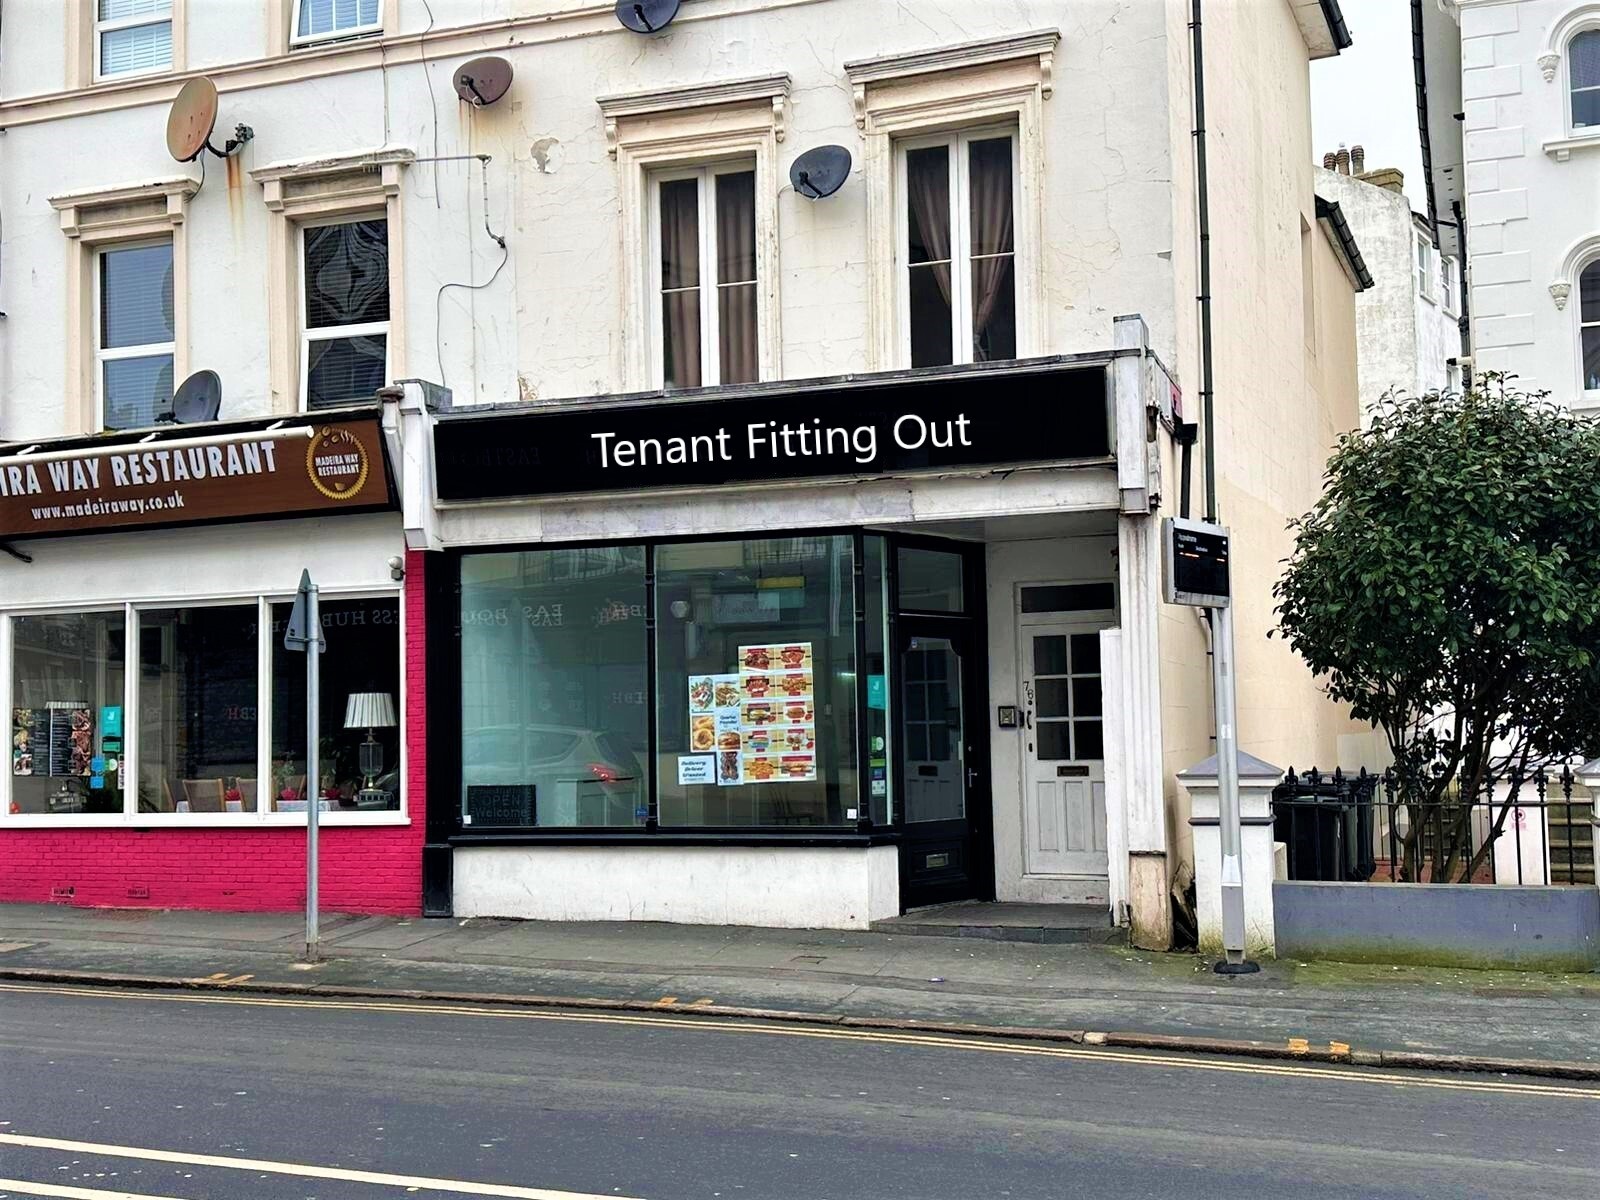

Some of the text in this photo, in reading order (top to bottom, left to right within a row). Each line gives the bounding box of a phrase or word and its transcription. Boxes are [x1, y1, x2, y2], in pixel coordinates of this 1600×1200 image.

[591, 413, 972, 469] Tenant Fitting Out
[48, 458, 100, 492] WAY
[110, 440, 275, 487] RESTAURANT
[315, 454, 359, 467] MADEIRA WAY
[318, 464, 359, 477] RESTAURANT
[31, 489, 185, 520] www.madeiraway.co.uk
